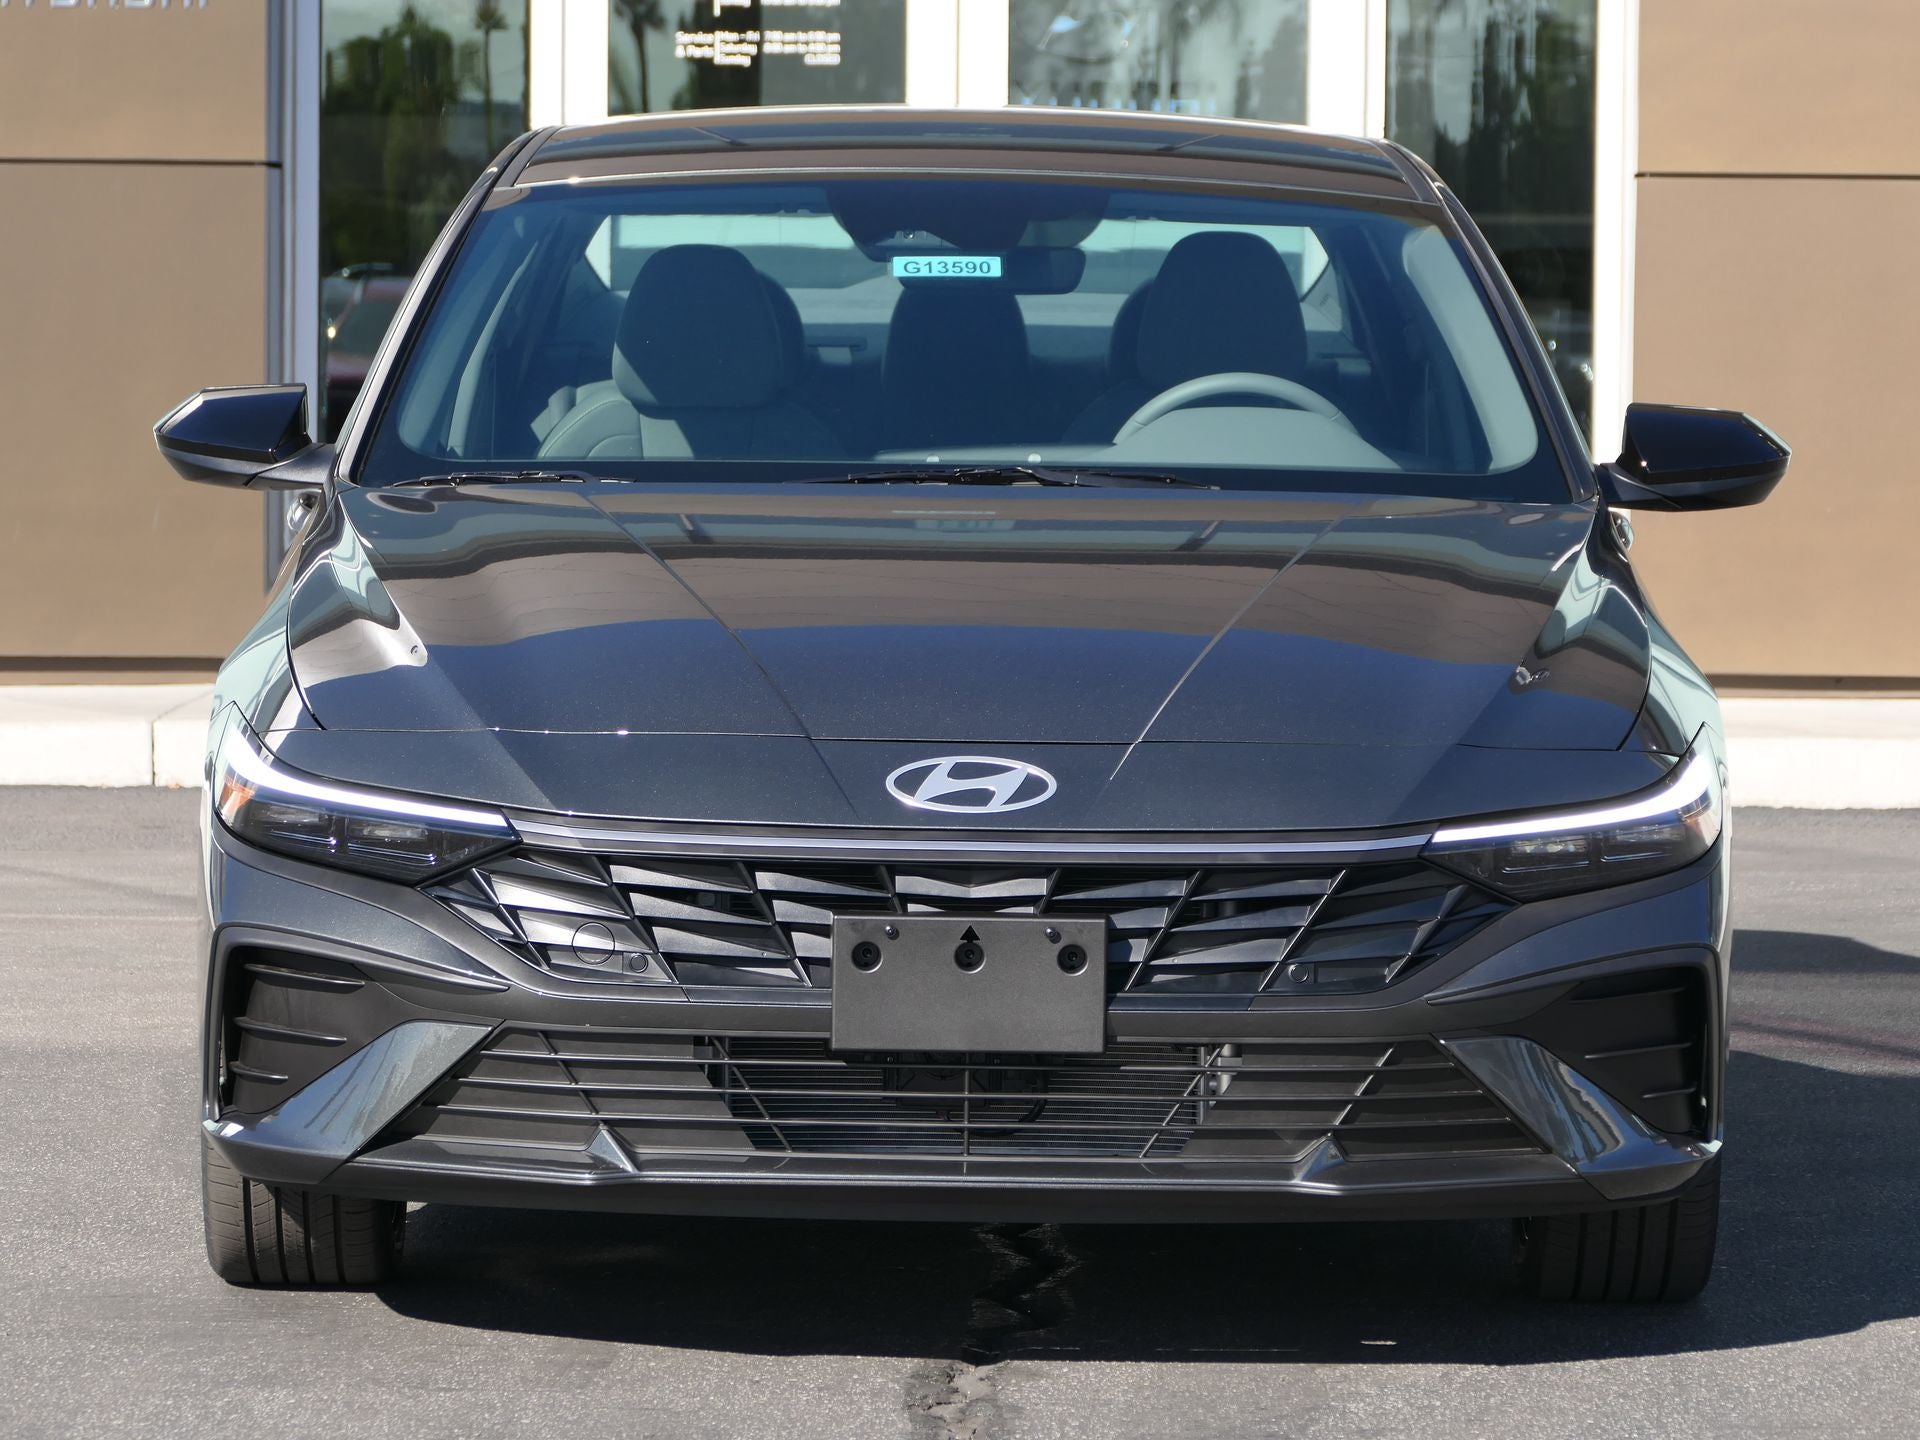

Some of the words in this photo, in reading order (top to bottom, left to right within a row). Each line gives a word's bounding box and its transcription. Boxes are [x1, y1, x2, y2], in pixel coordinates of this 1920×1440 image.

[675, 31, 714, 45] Service
[720, 31, 739, 42] Mon
[686, 45, 714, 58] Parts
[720, 42, 758, 56] Saturday
[720, 53, 750, 67] Sunday
[903, 260, 992, 274] G13590
